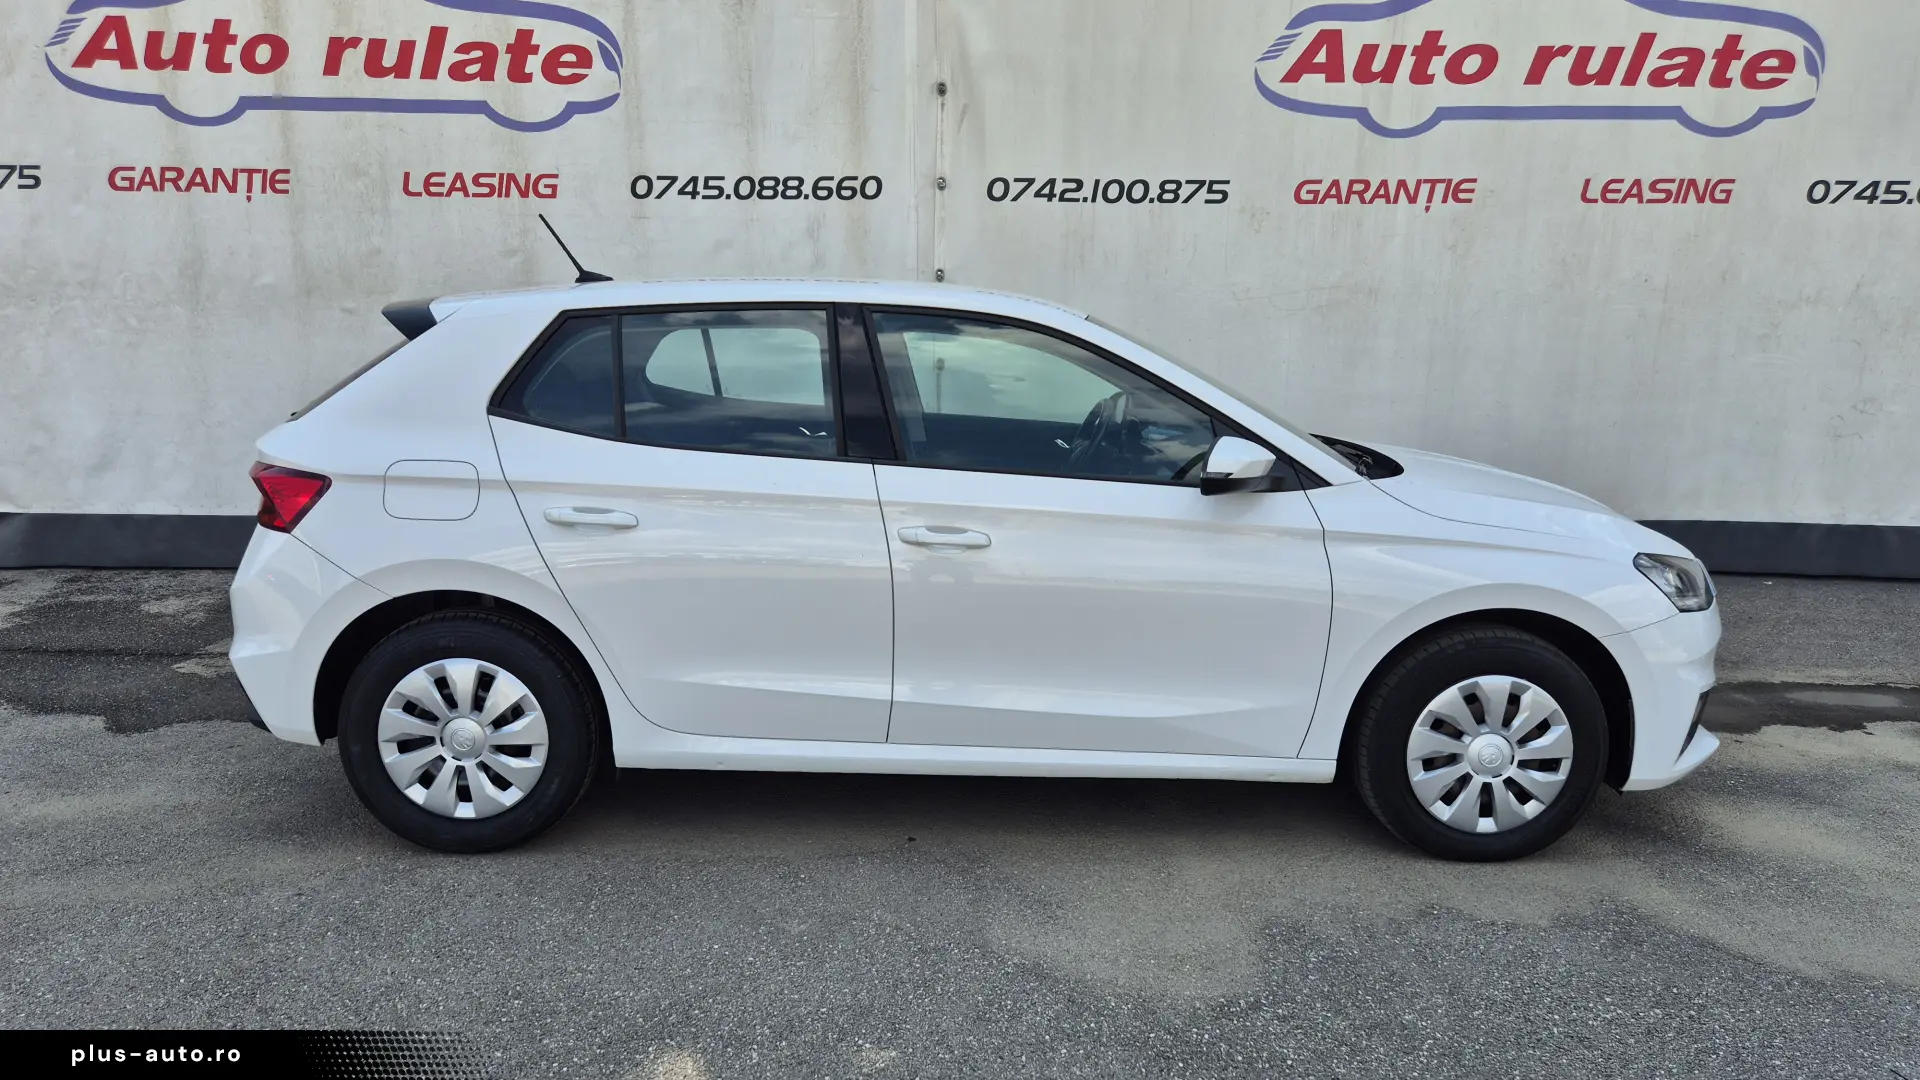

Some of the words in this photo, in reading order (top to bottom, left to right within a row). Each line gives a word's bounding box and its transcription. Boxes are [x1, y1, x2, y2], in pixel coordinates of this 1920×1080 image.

[71, 15, 290, 75] Auto
[322, 25, 594, 86] rulate
[1280, 28, 1499, 86] Auto
[1523, 32, 1796, 90] rulate
[108, 166, 291, 203] GARANȚIE
[402, 171, 559, 199] LEASING
[630, 174, 883, 201] 0745.088.660
[986, 176, 1231, 205] 0742.100.875
[1293, 177, 1478, 214] GARANȚIE
[1580, 178, 1736, 205] LEASING
[1806, 179, 1920, 205] 0745.
